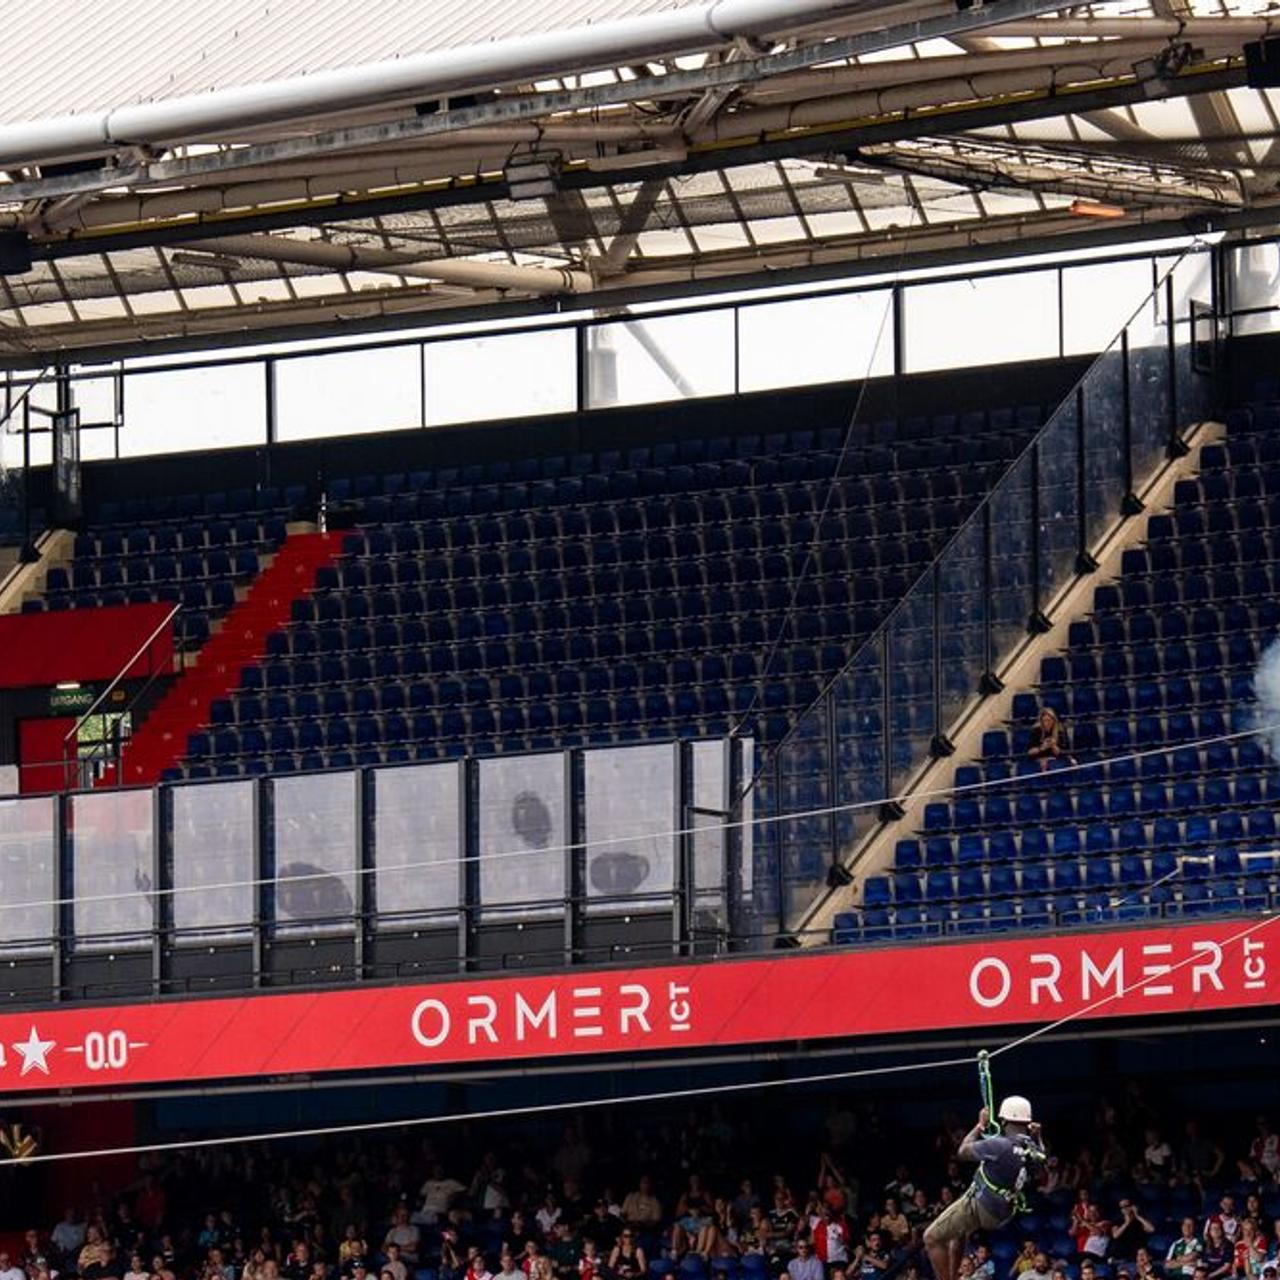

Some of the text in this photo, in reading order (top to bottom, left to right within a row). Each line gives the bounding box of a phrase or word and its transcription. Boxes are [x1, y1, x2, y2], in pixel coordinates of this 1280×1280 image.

[970, 937, 1266, 1007] ORMER ICT
[411, 981, 691, 1047] ORMER ICT
